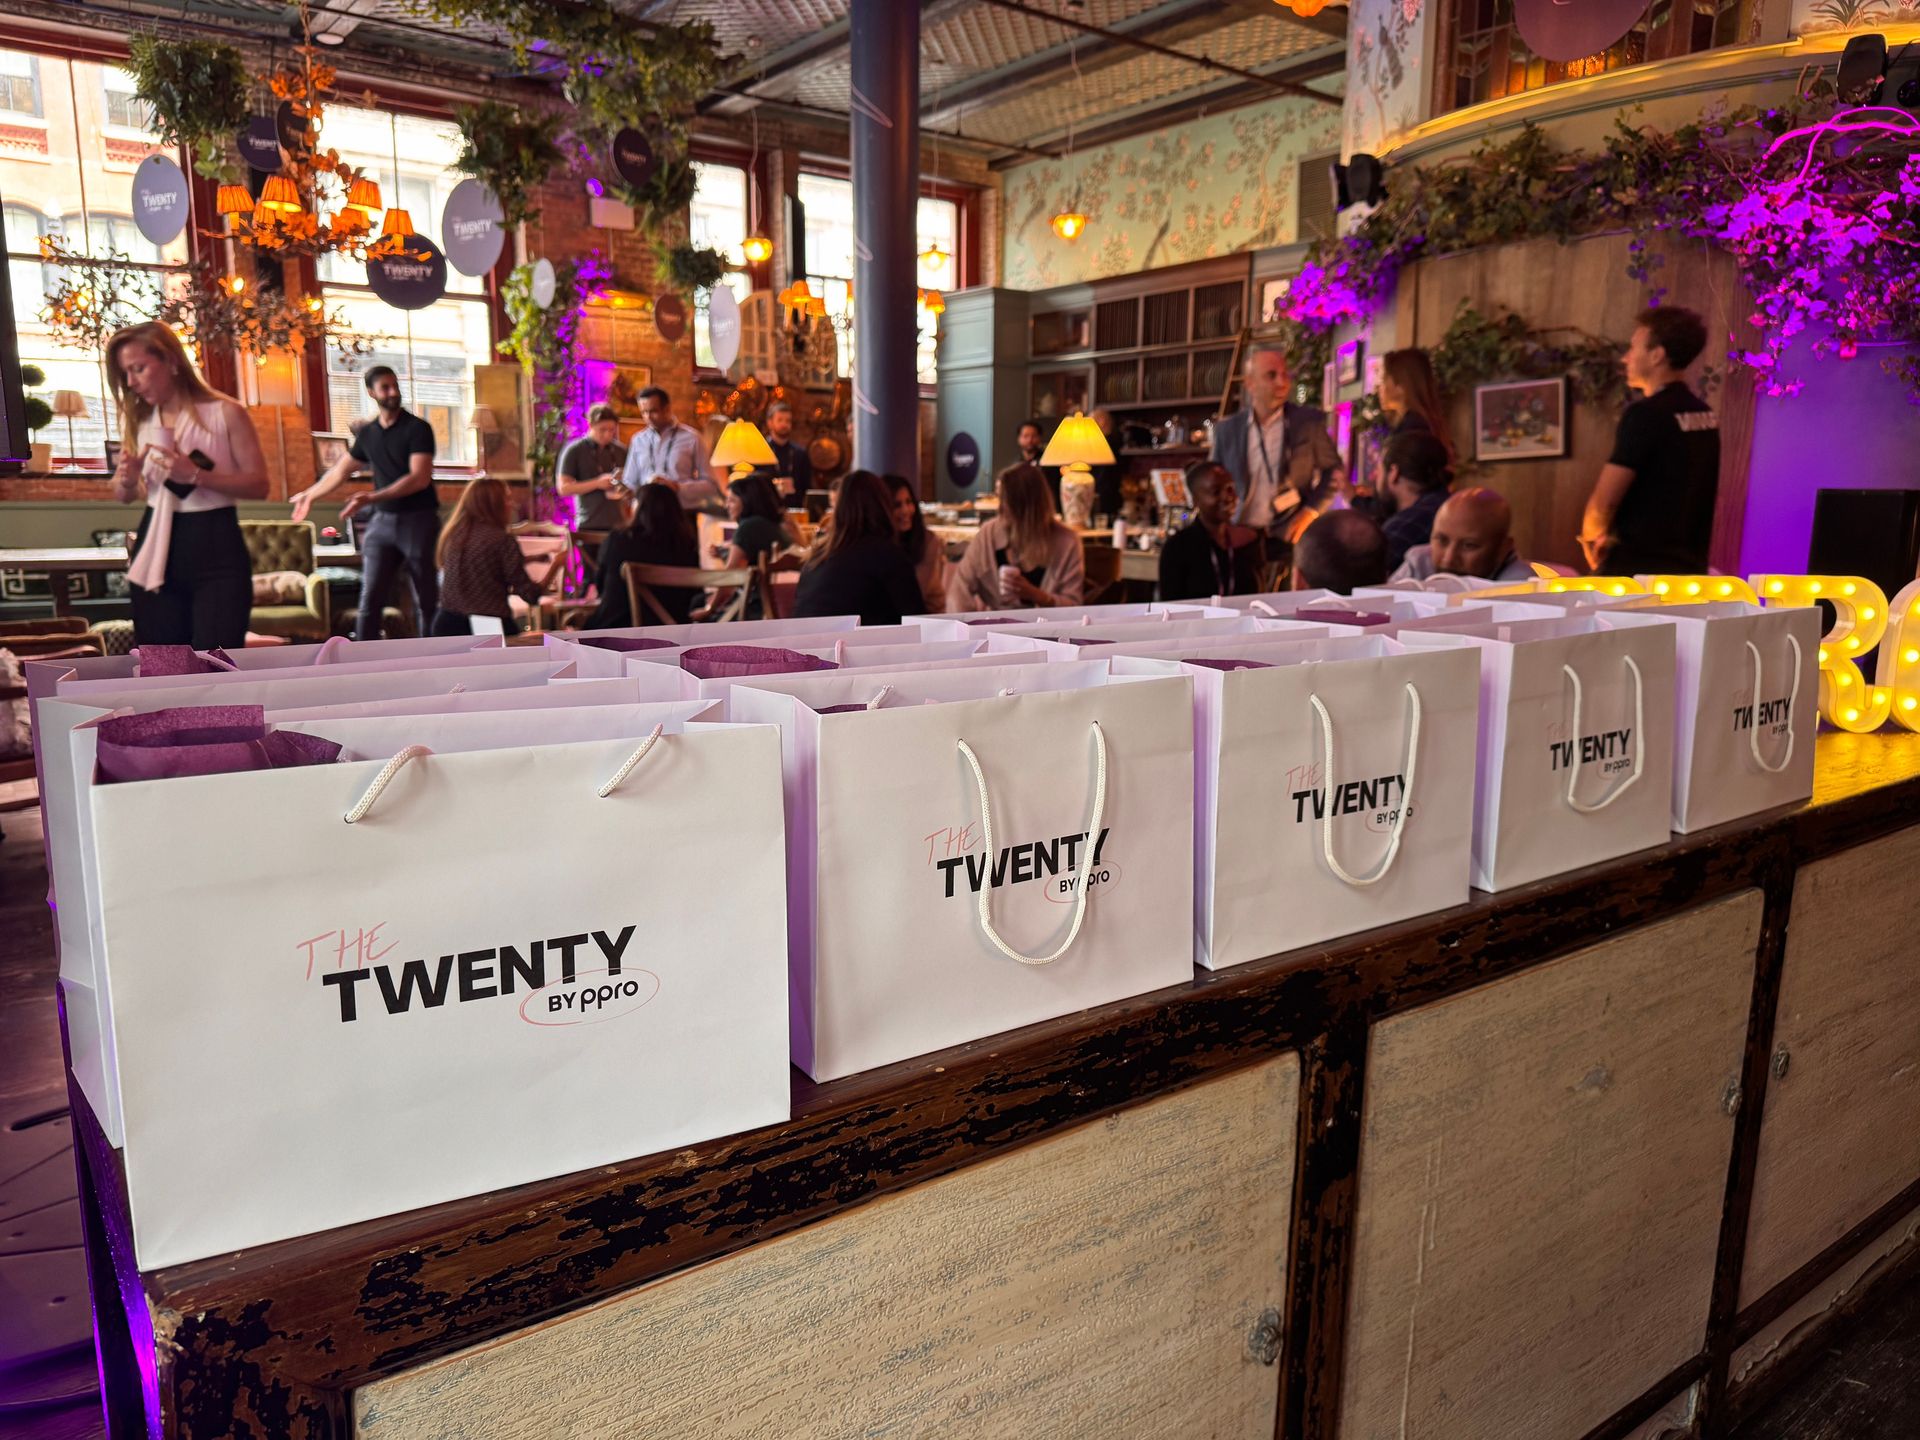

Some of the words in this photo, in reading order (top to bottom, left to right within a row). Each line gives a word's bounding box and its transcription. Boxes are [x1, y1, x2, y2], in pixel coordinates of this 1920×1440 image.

[383, 263, 433, 277] TWENTY
[1550, 728, 1631, 771] TWENTY
[1285, 761, 1323, 797] THE
[1376, 811, 1388, 824] BY
[1389, 806, 1414, 825] ppo
[924, 821, 982, 866] THE
[936, 827, 1111, 899] TWENTY
[1059, 877, 1076, 893] BY
[1077, 869, 1111, 893] pro
[296, 921, 400, 981] THE
[321, 924, 637, 1023] TWENTY
[548, 991, 576, 1012] BY
[580, 980, 639, 1013] ppro
